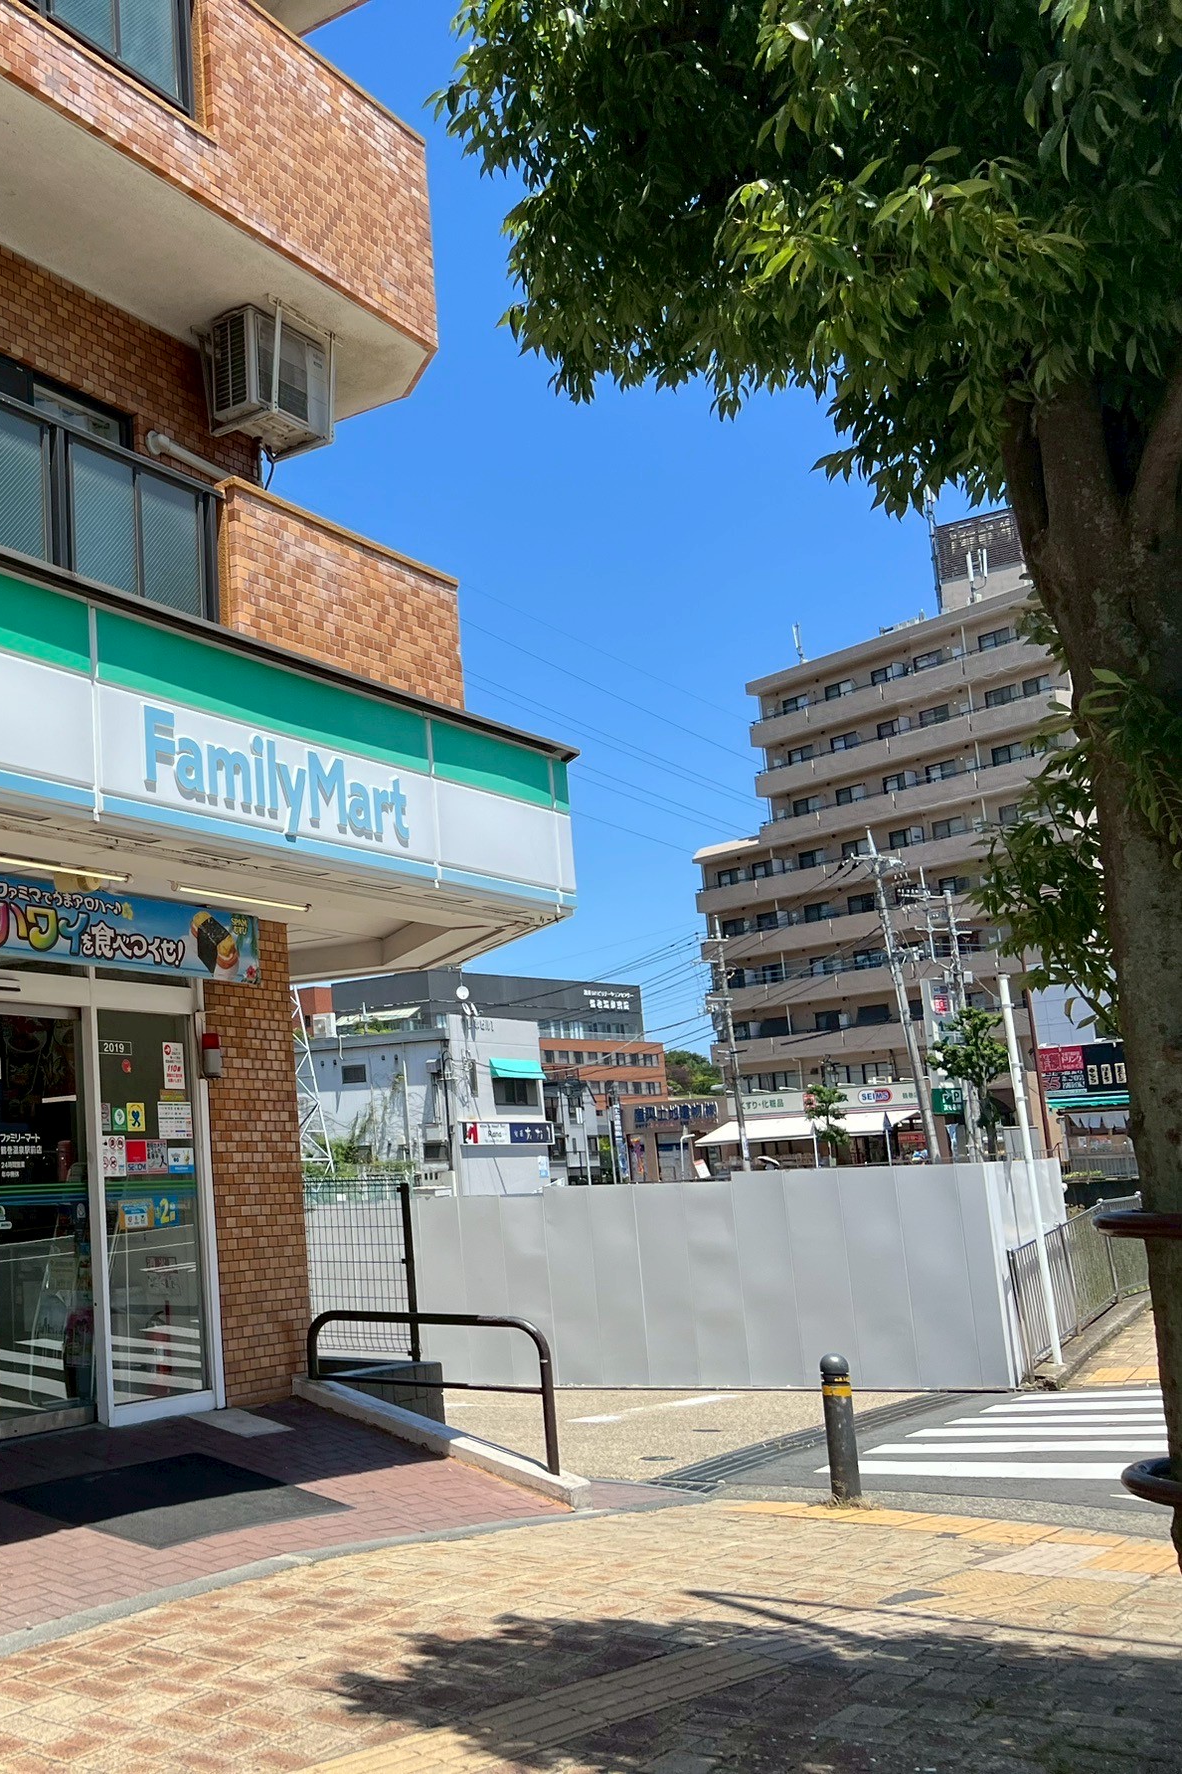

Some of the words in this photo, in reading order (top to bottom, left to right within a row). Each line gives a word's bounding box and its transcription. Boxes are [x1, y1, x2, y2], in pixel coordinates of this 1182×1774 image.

[141, 701, 410, 845] FamilyMart
[103, 1042, 125, 1053] 2019
[861, 1091, 888, 1100] SEIMS
[0, 1133, 40, 1142] ファミリーマート
